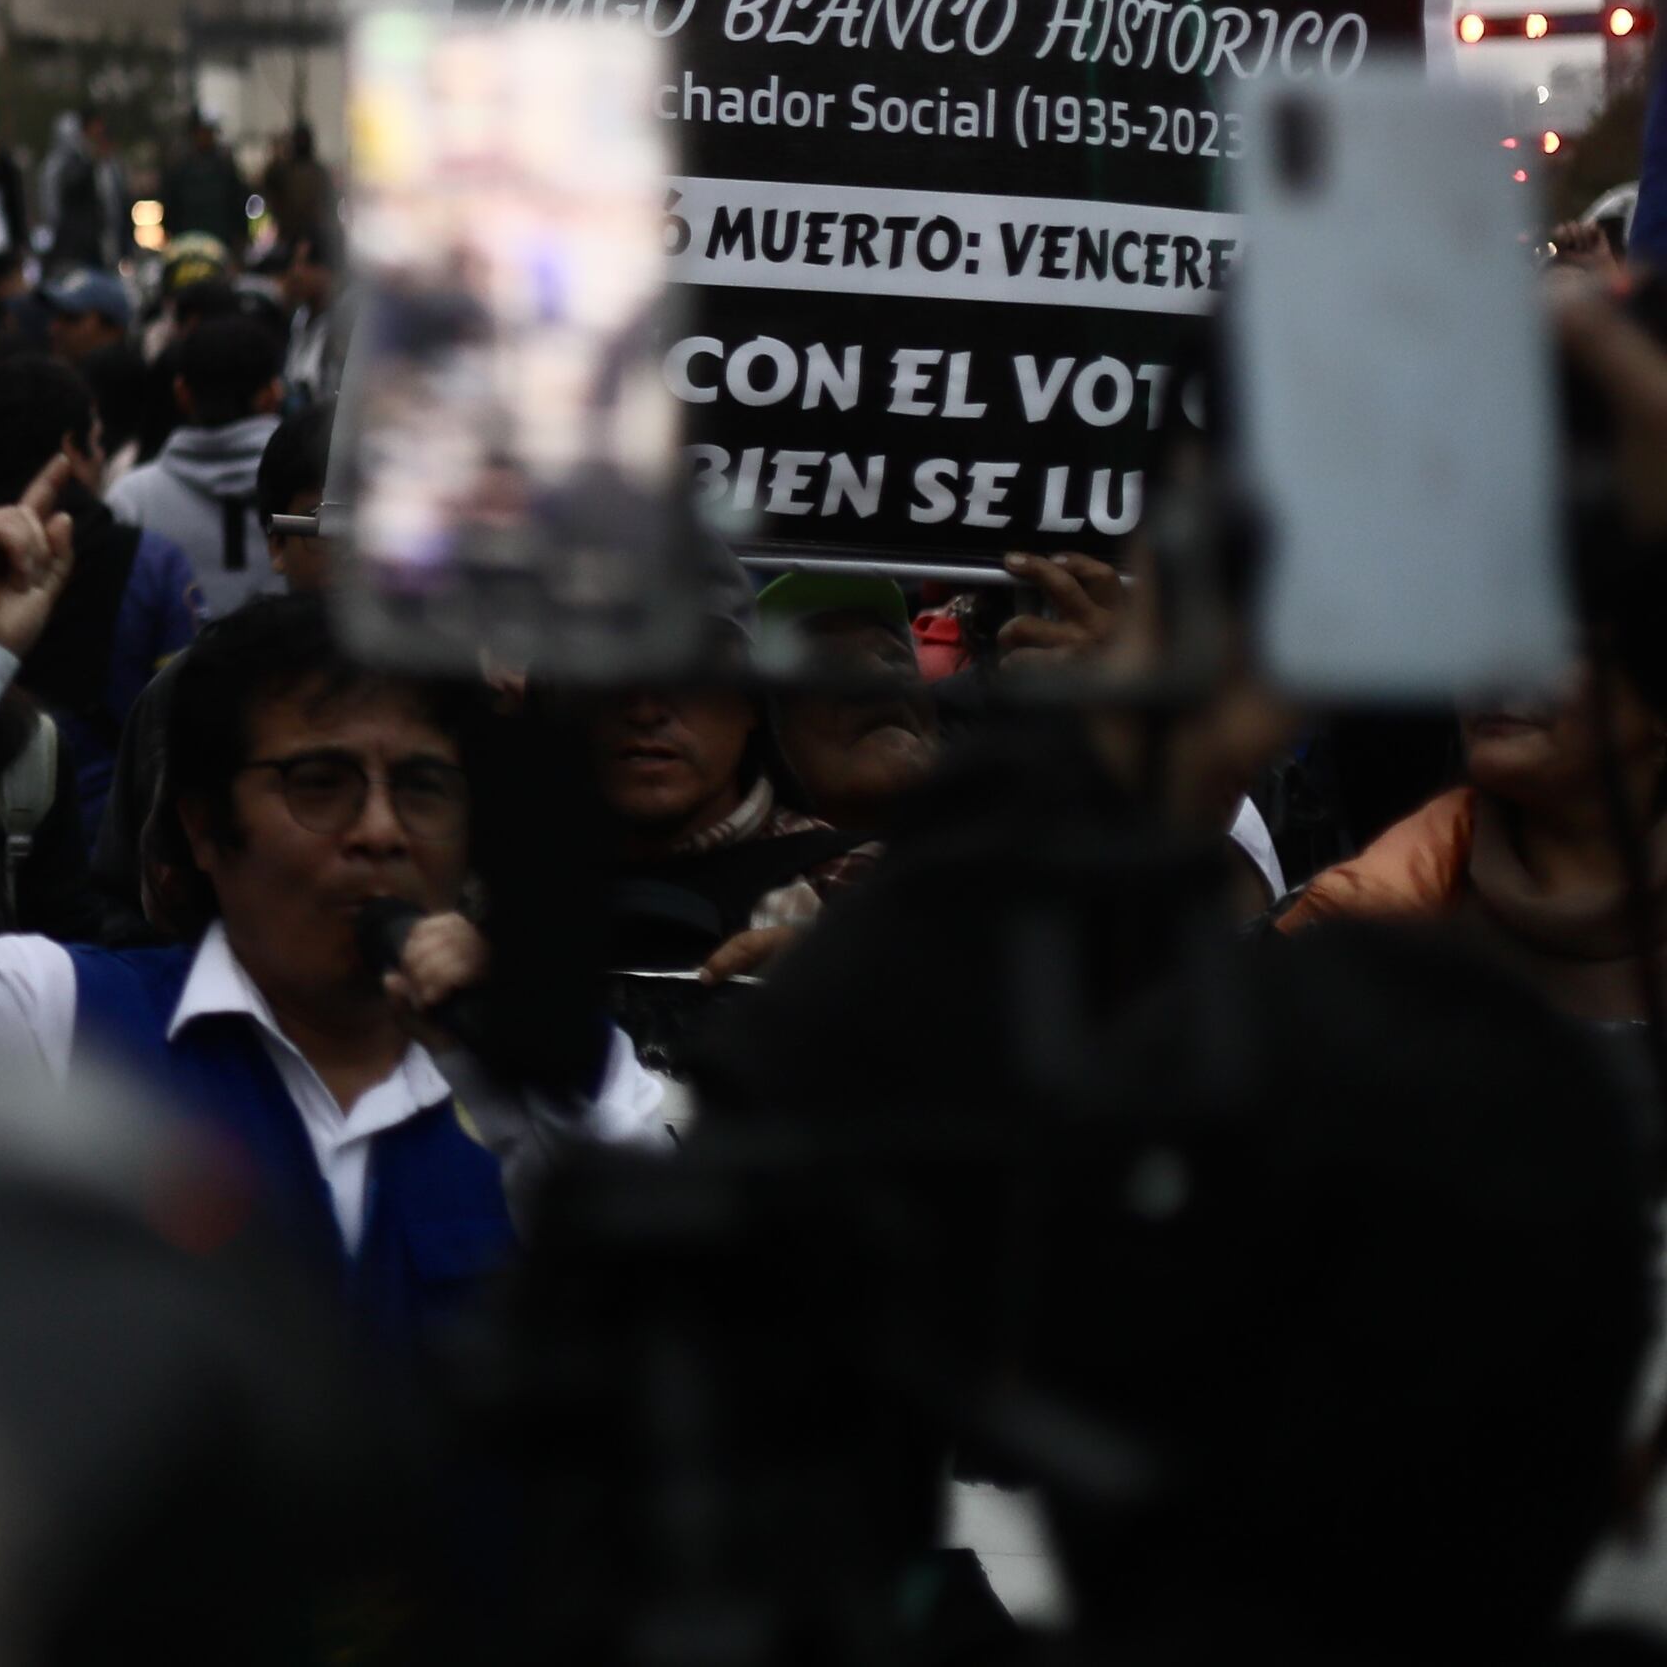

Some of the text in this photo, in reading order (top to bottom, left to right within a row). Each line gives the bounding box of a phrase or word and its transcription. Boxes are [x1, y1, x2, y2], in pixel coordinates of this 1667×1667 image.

[655, 71, 1245, 161] chador Social (1935-2023
[705, 206, 980, 276] MUERTO:
[999, 222, 1235, 291] VENCERE
[668, 335, 863, 412] CON
[887, 347, 987, 418] EL
[687, 442, 1144, 535] BIEN SE LU
